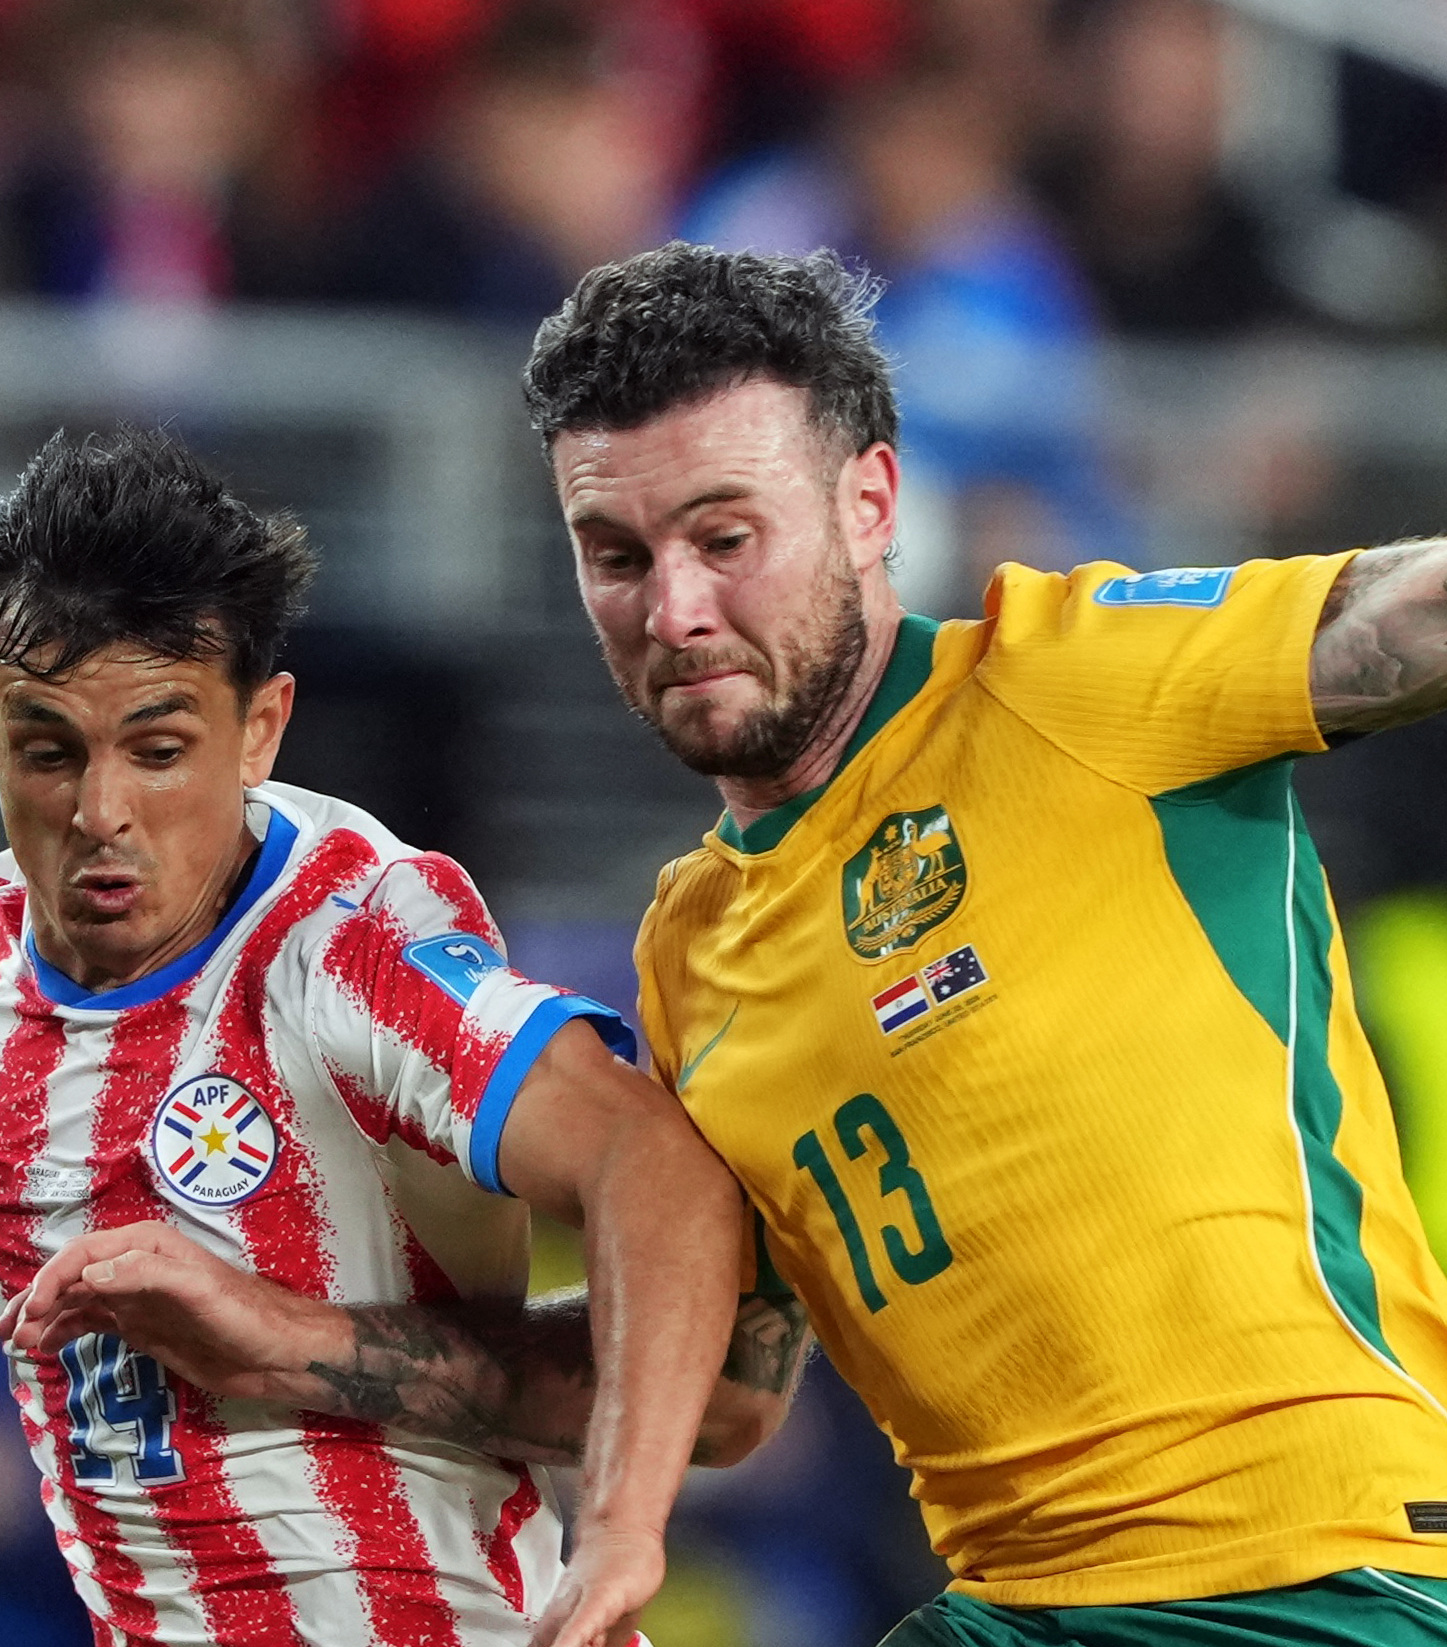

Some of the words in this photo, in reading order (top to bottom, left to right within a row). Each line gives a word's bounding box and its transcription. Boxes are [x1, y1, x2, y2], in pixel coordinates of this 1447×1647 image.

[862, 876, 950, 935] AUSTRALIA
[193, 1084, 230, 1108] APF
[192, 1178, 250, 1199] PARAGUAY
[792, 1092, 954, 1316] 13
[59, 1332, 187, 1488] 14
